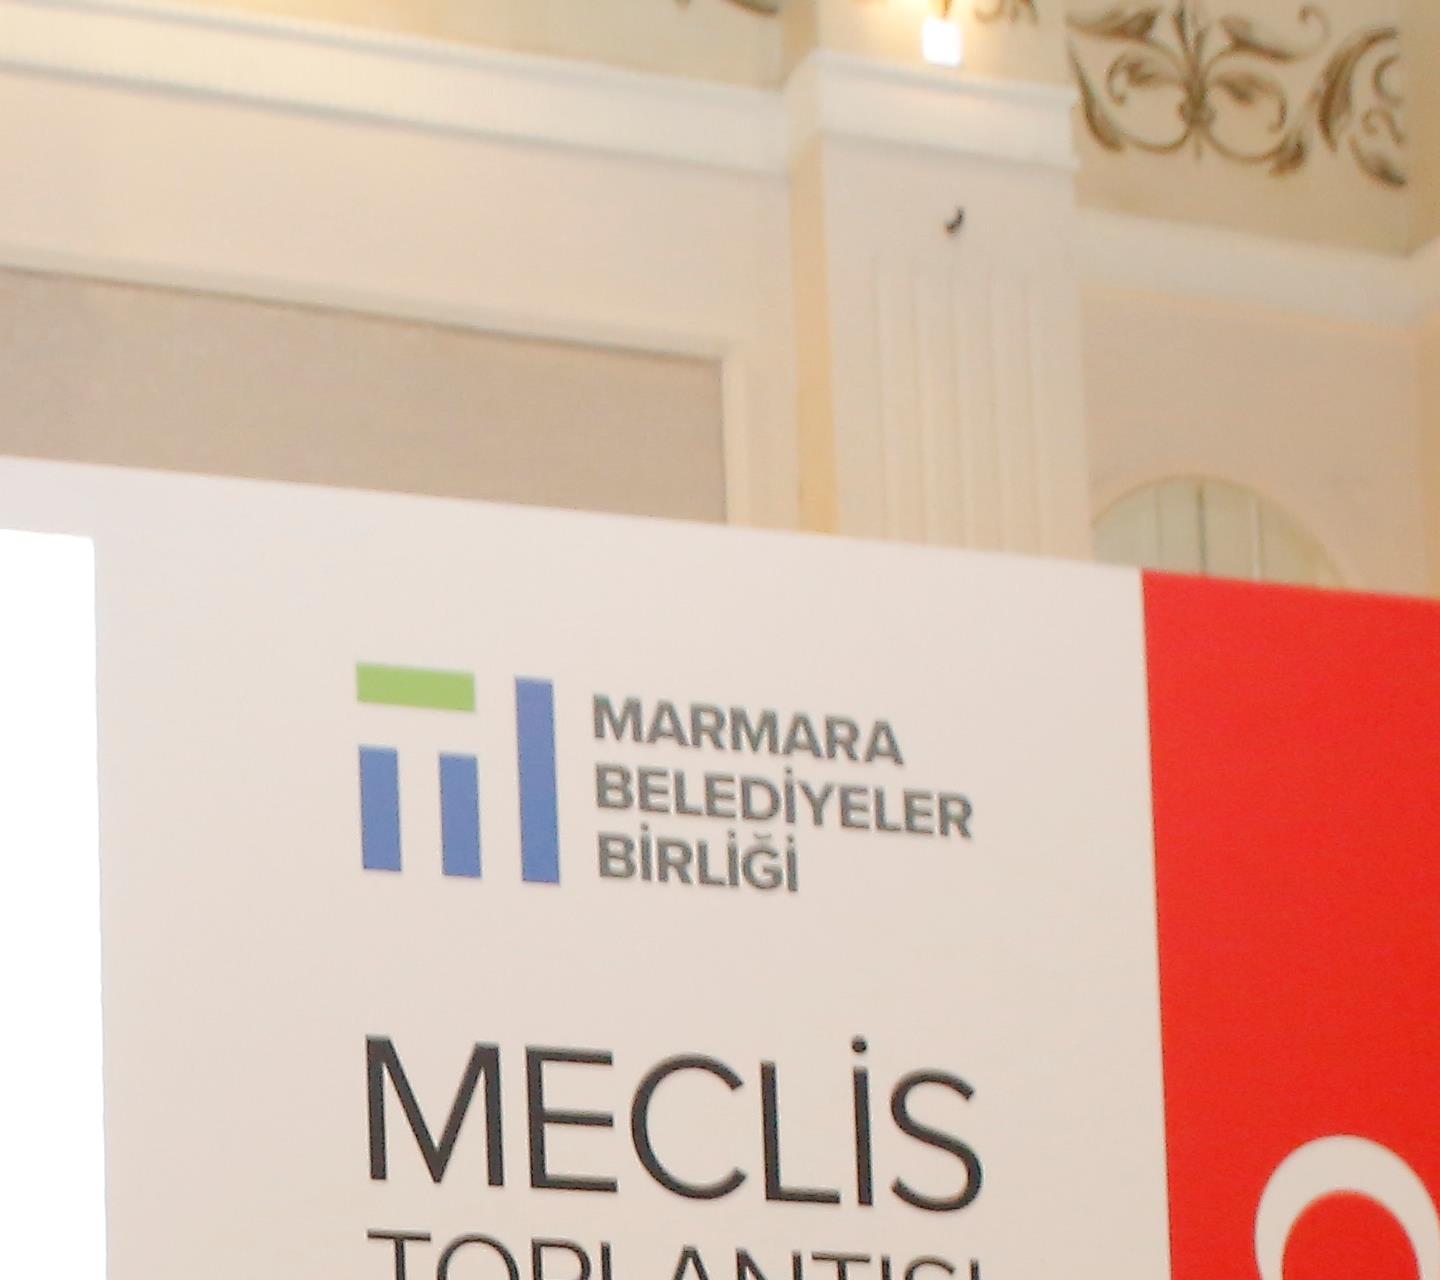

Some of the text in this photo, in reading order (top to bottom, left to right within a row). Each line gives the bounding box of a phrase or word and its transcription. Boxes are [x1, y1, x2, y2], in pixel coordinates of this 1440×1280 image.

[592, 693, 905, 767] MARMARA
[595, 763, 974, 840] BELEDİYELER
[598, 822, 800, 893] BİRLİĞİ
[365, 1034, 985, 1213] MECLİS
